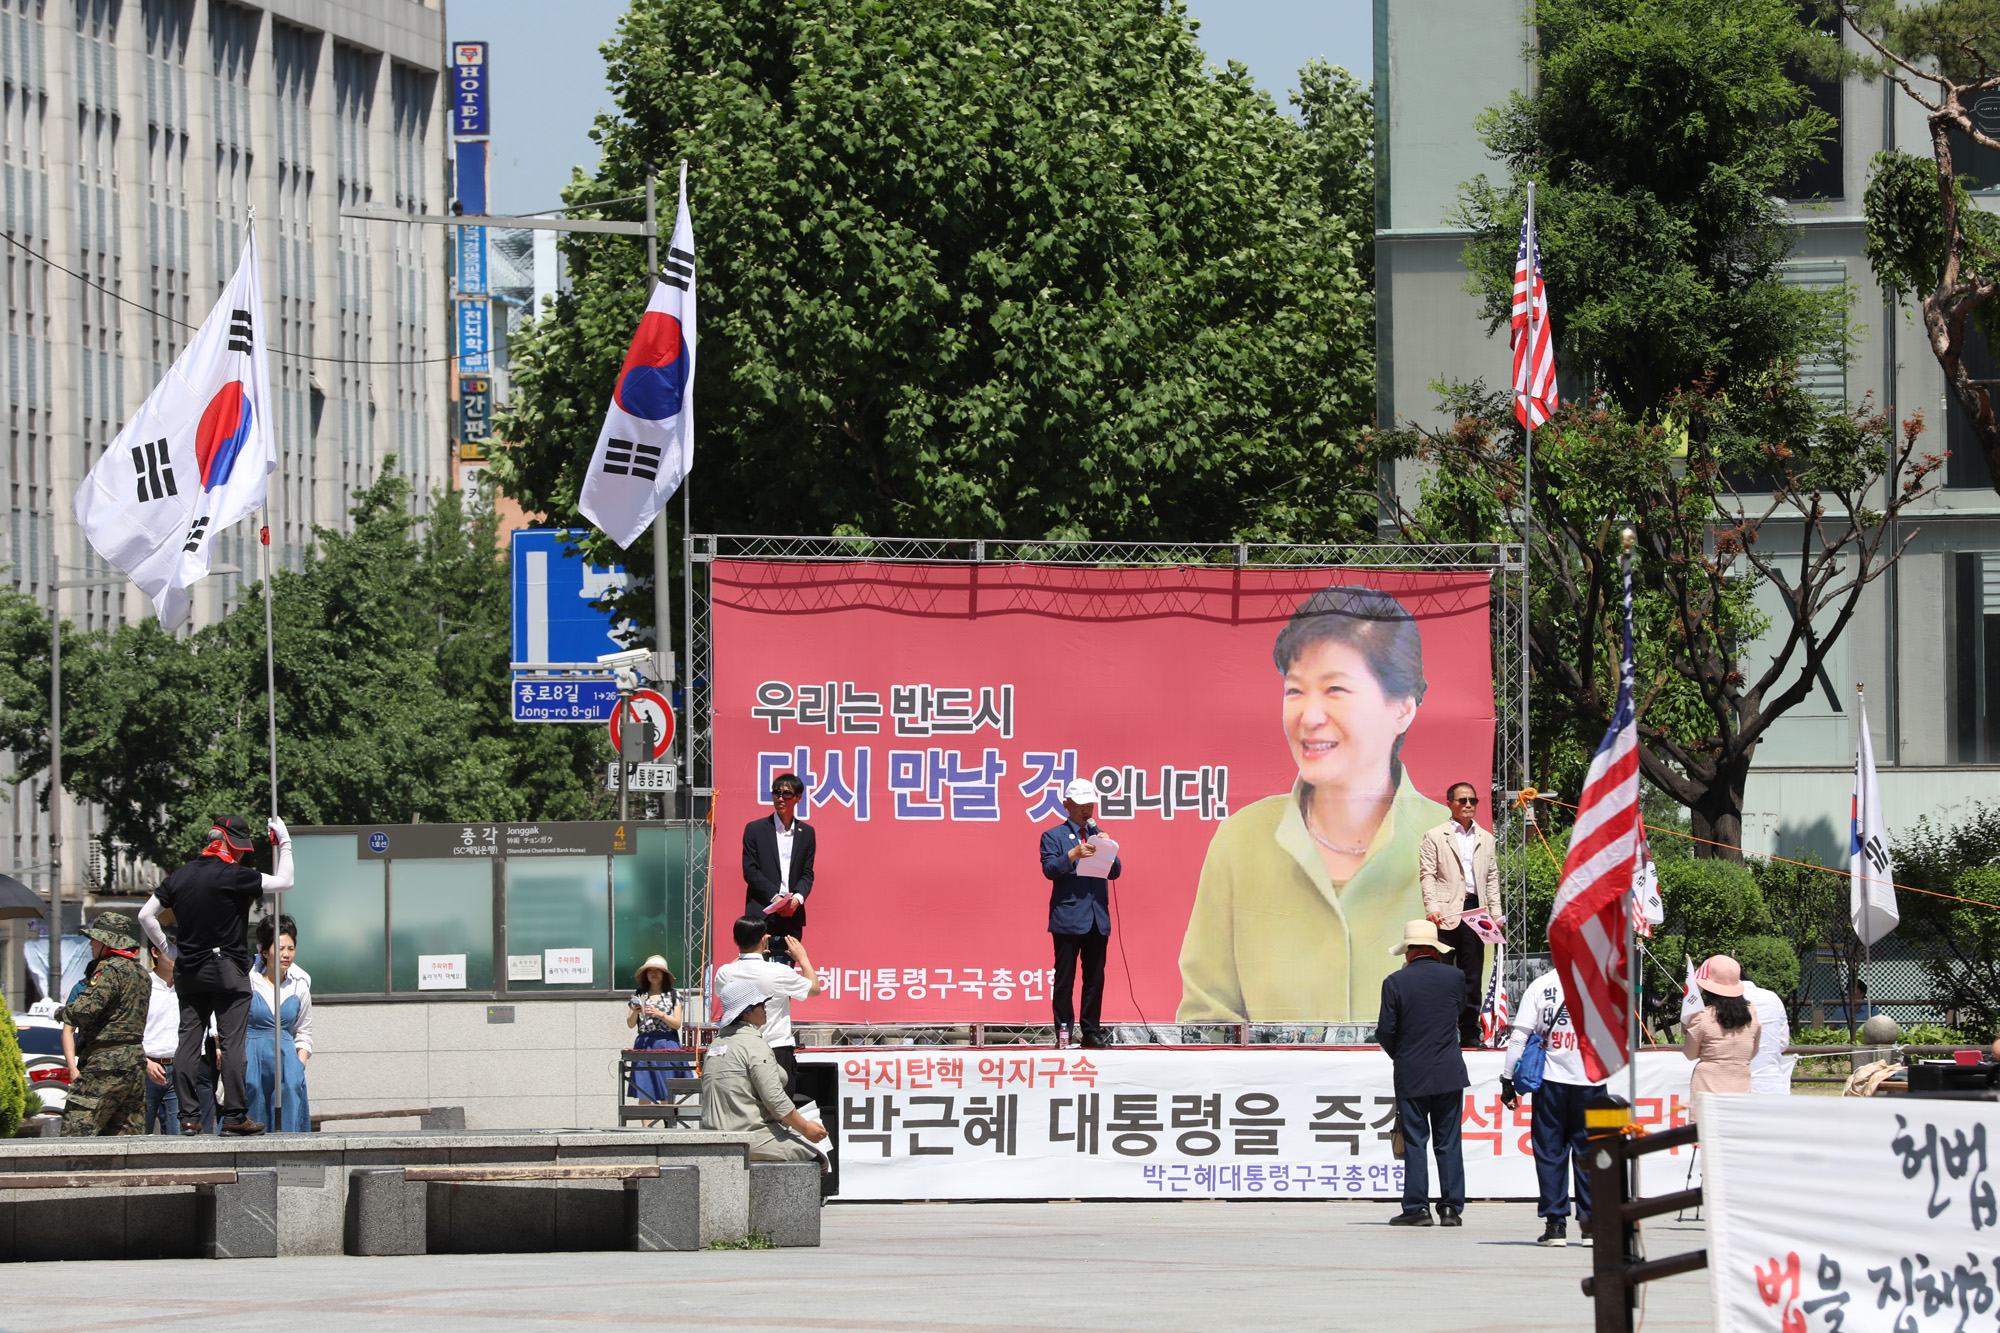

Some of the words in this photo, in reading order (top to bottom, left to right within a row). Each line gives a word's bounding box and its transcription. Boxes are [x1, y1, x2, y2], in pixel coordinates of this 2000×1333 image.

[460, 66, 479, 130] HOTEL
[462, 381, 487, 392] LED
[464, 395, 487, 442] 간판
[519, 684, 579, 703] 종로8길
[519, 706, 568, 719] Jong-ro
[571, 706, 599, 719] 8-gil
[751, 680, 883, 734] 우리는
[890, 684, 1013, 738] 반드시
[757, 745, 870, 821] 다시
[888, 747, 1006, 822] 만날
[506, 826, 539, 836] Jonggak
[615, 826, 625, 840] 4
[453, 846, 498, 855] (SC제일은행)
[844, 1057, 963, 1090] 억지탄핵
[978, 1056, 1098, 1089] 억지구속
[843, 1093, 1018, 1157] 박근혜
[1050, 1093, 1285, 1156] 대통령을
